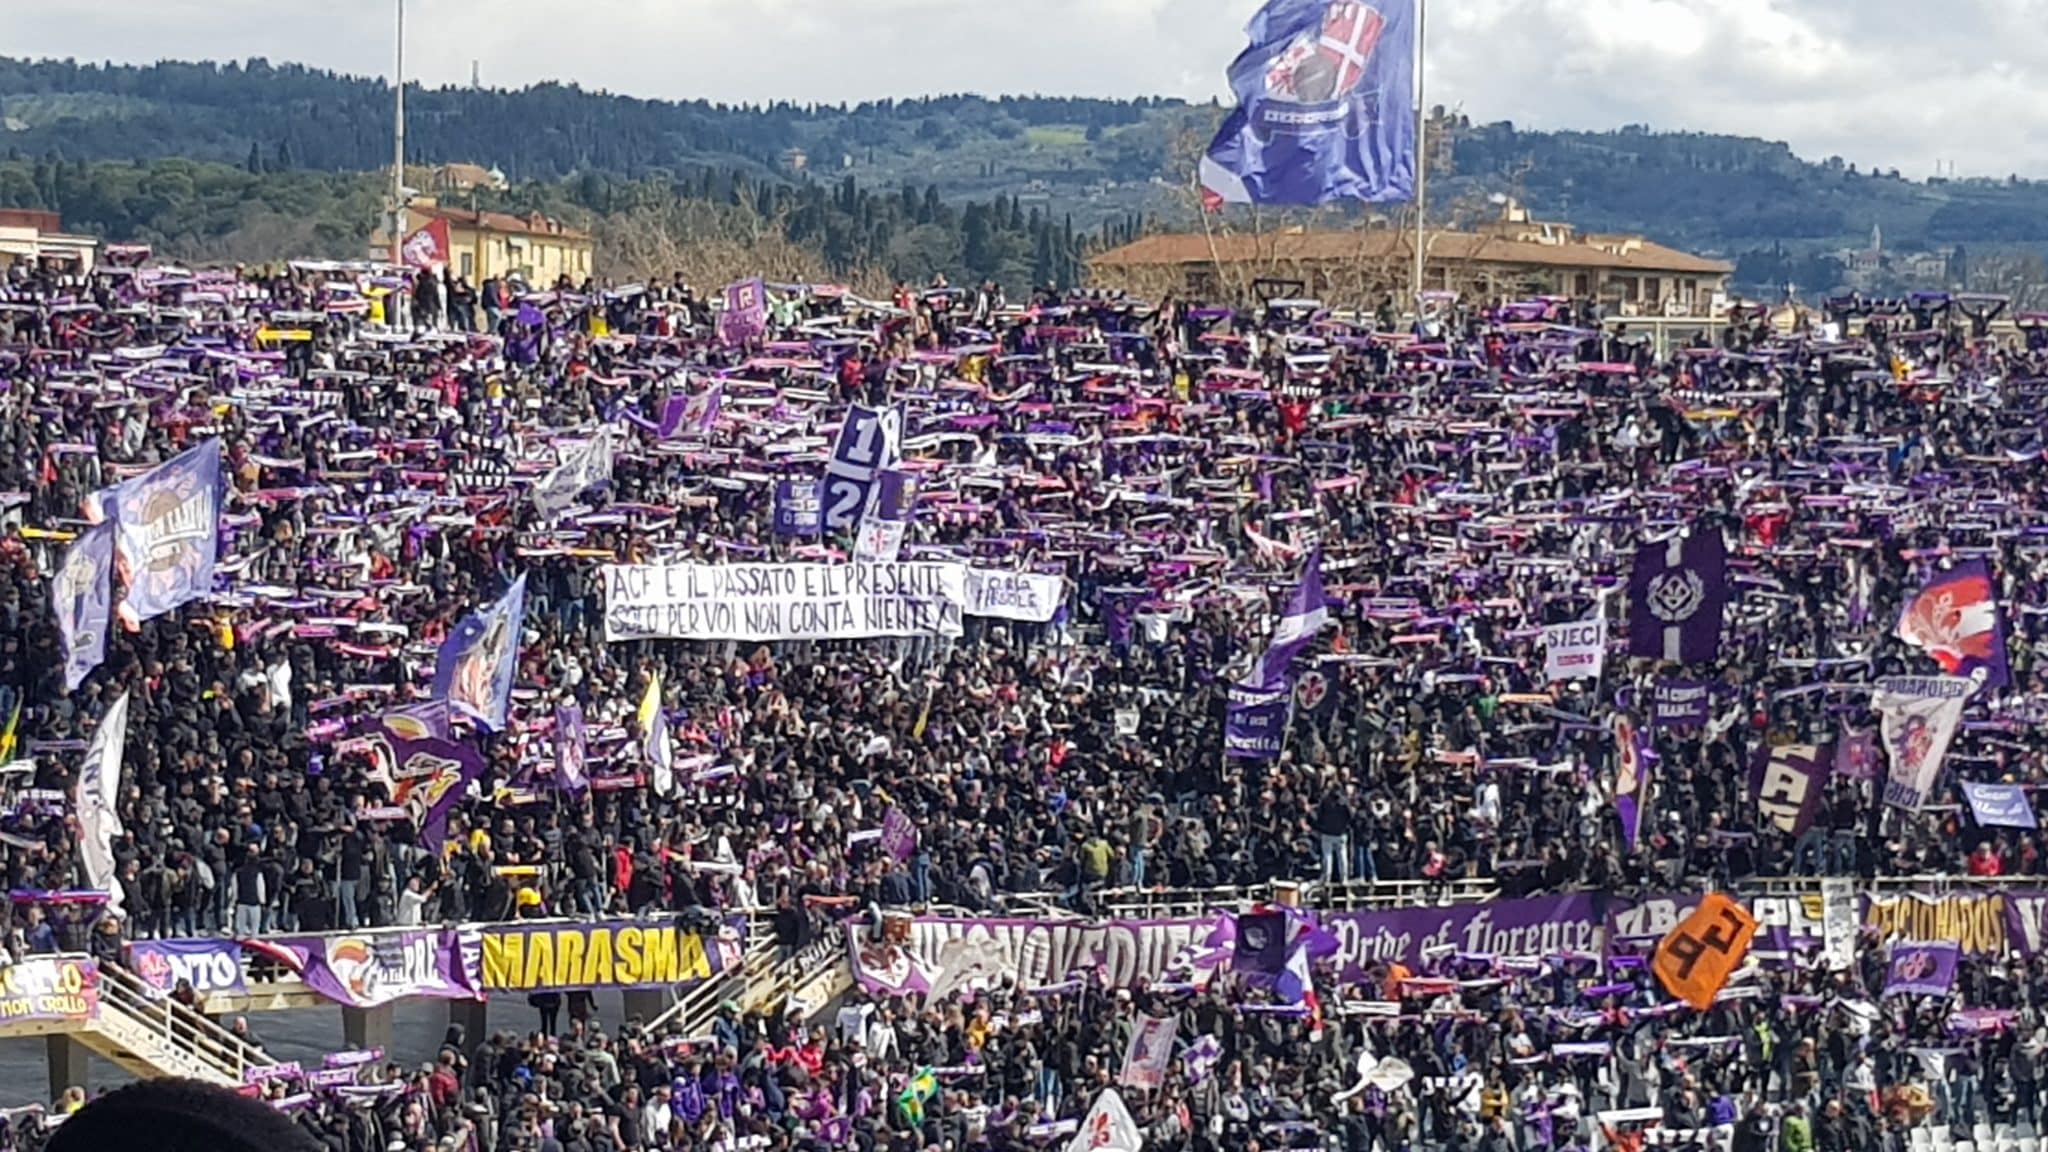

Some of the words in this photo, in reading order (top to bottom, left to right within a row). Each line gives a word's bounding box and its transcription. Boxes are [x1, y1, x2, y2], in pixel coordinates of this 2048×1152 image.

[713, 567, 796, 598] PASSATO
[845, 563, 946, 597] PRESENTE
[667, 602, 699, 635] PER
[703, 601, 737, 633] VOI
[744, 601, 781, 634] NON
[789, 599, 855, 634] CONTA
[864, 597, 938, 632] NIENTE
[1548, 624, 1601, 649] SIECI
[483, 926, 711, 989] MARASMA
[1330, 918, 1411, 972] Pride
